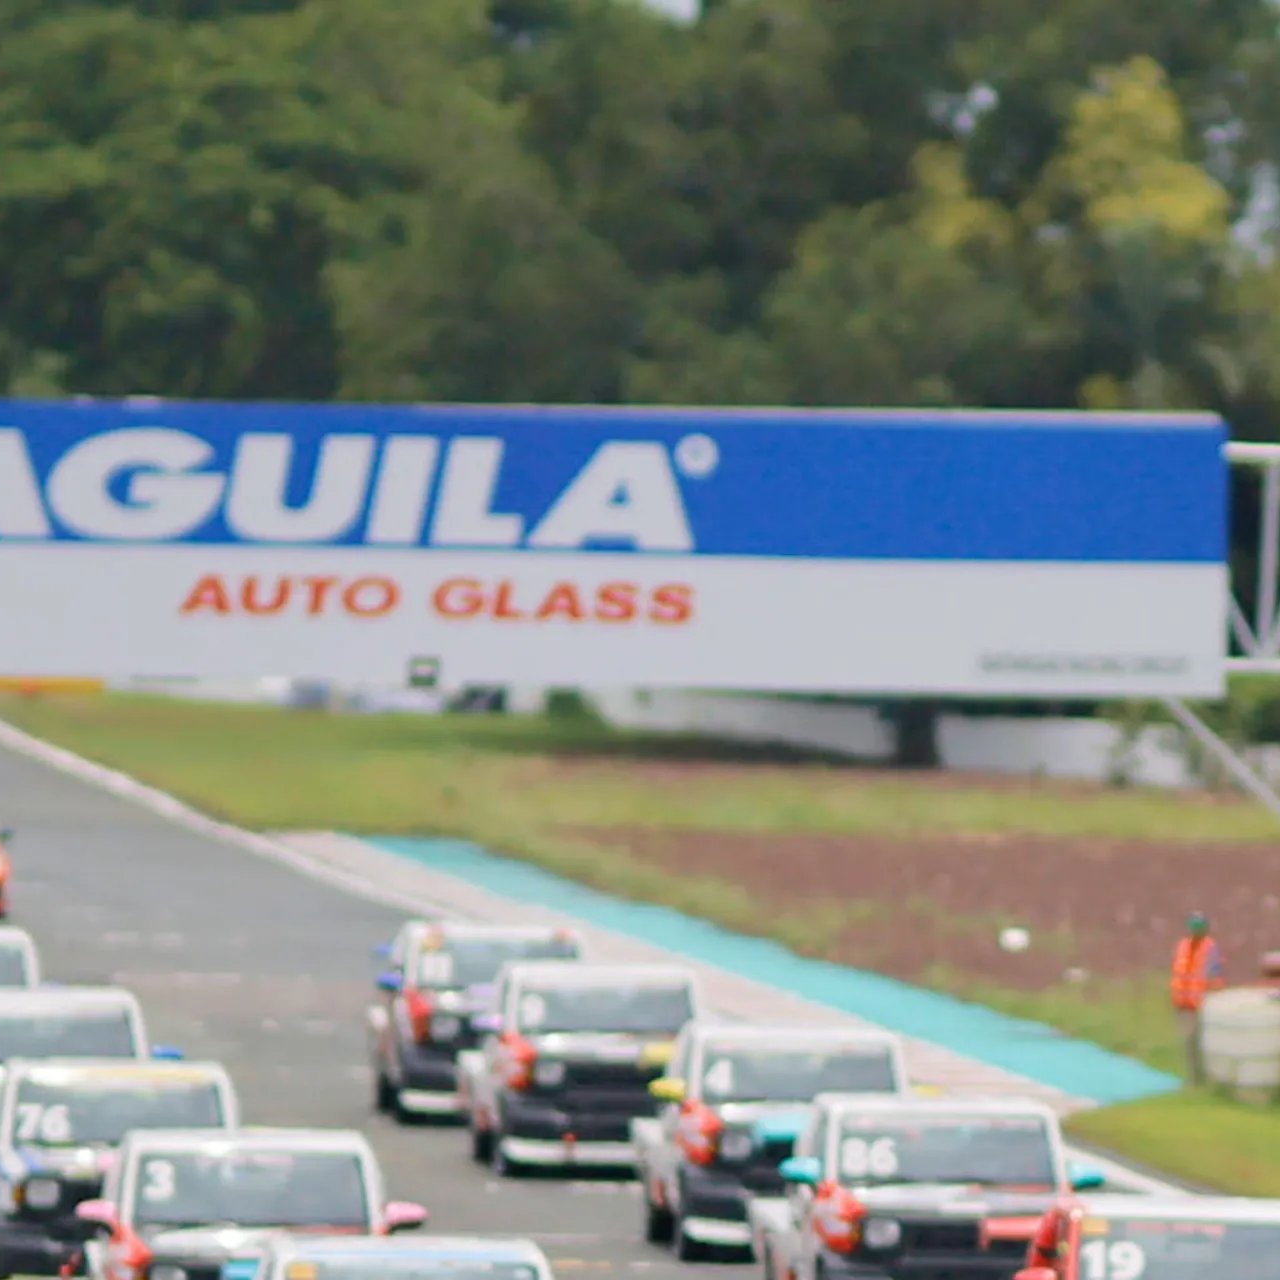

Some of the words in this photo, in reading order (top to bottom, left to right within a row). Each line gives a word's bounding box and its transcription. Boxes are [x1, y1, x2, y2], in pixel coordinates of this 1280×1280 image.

[179, 573, 400, 618] AUTO
[431, 576, 696, 625] GLASS
[17, 1104, 70, 1141] 76
[841, 1138, 899, 1178] 86
[141, 1159, 176, 1201] 3
